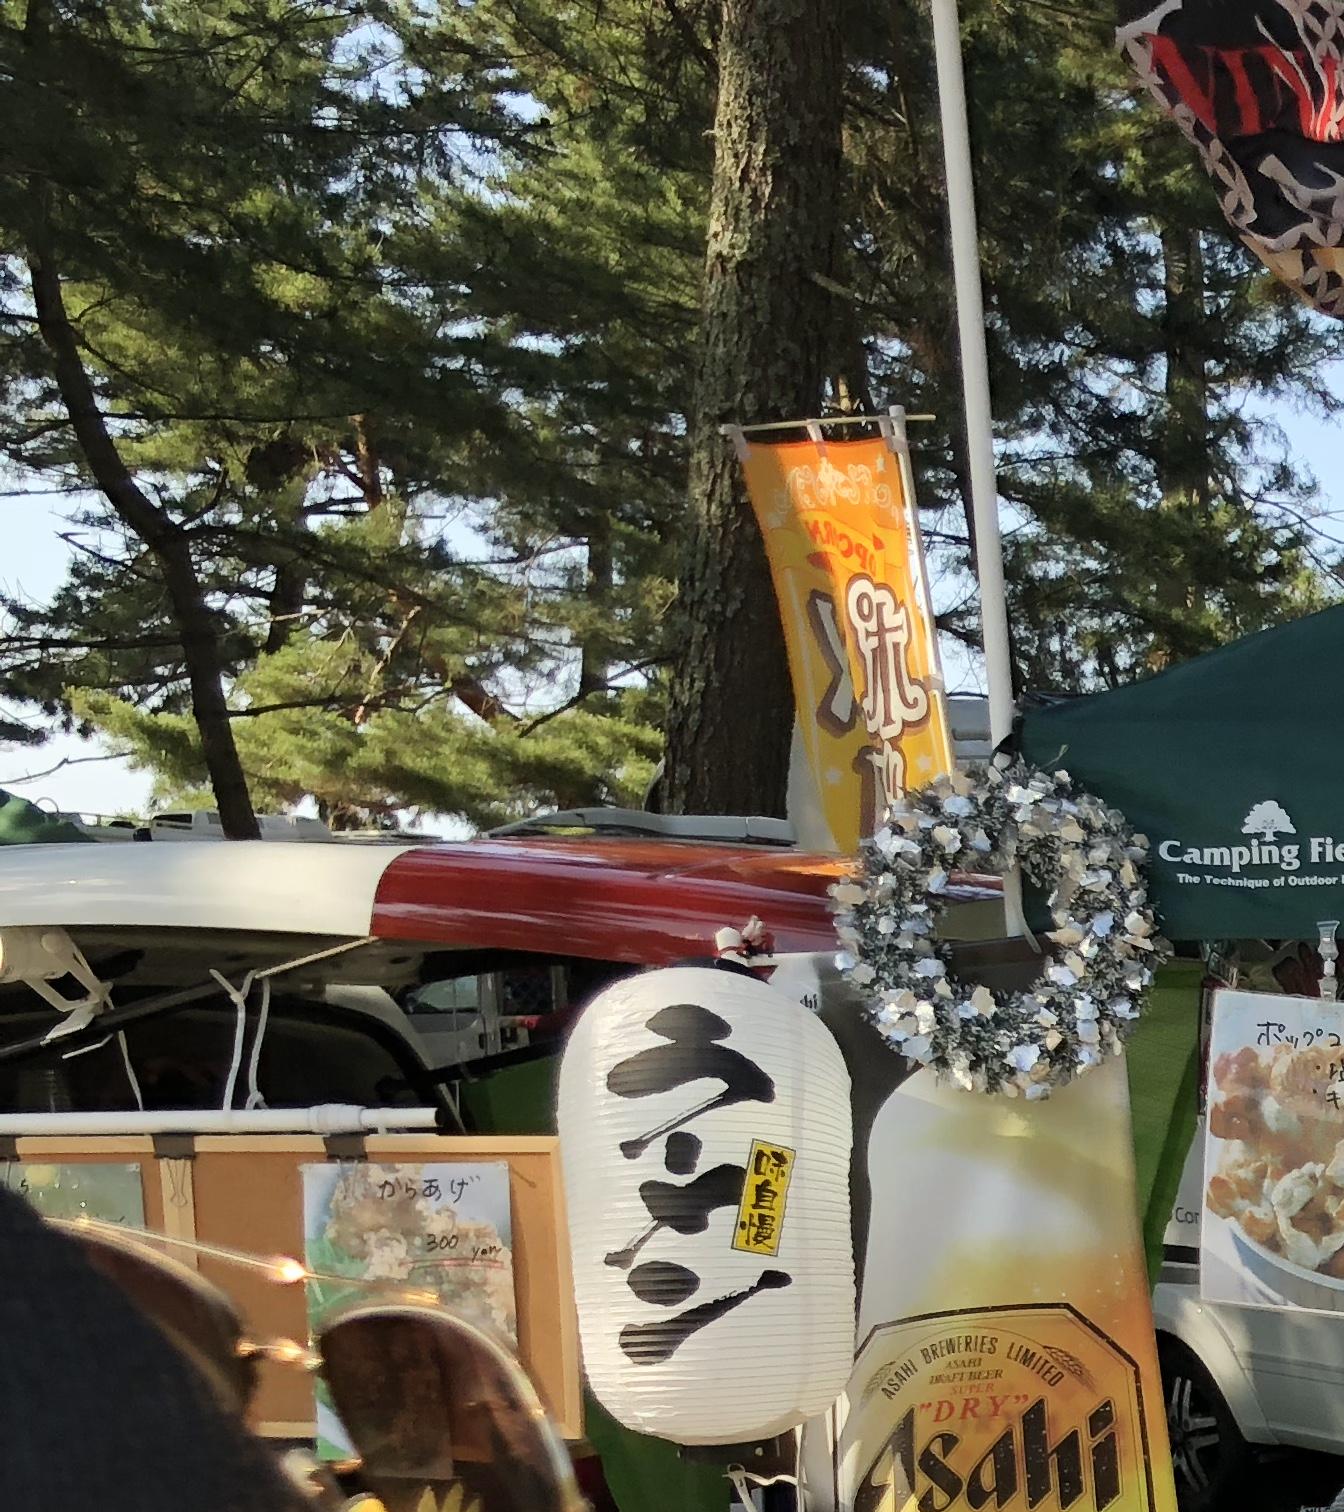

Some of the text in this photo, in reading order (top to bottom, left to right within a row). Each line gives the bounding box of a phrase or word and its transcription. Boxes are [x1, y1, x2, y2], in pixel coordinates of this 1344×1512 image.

[1158, 838, 1301, 873] Camping
[1177, 873, 1201, 884] The
[1204, 874, 1270, 889] Technique
[1273, 875, 1285, 887] of
[1288, 875, 1338, 886] Outdoor
[377, 1175, 480, 1203] からあげ
[739, 1149, 788, 1250] 味自慢
[426, 1233, 459, 1252] 300
[881, 1335, 1064, 1400] ASAHI BREWERIES LIMITED
